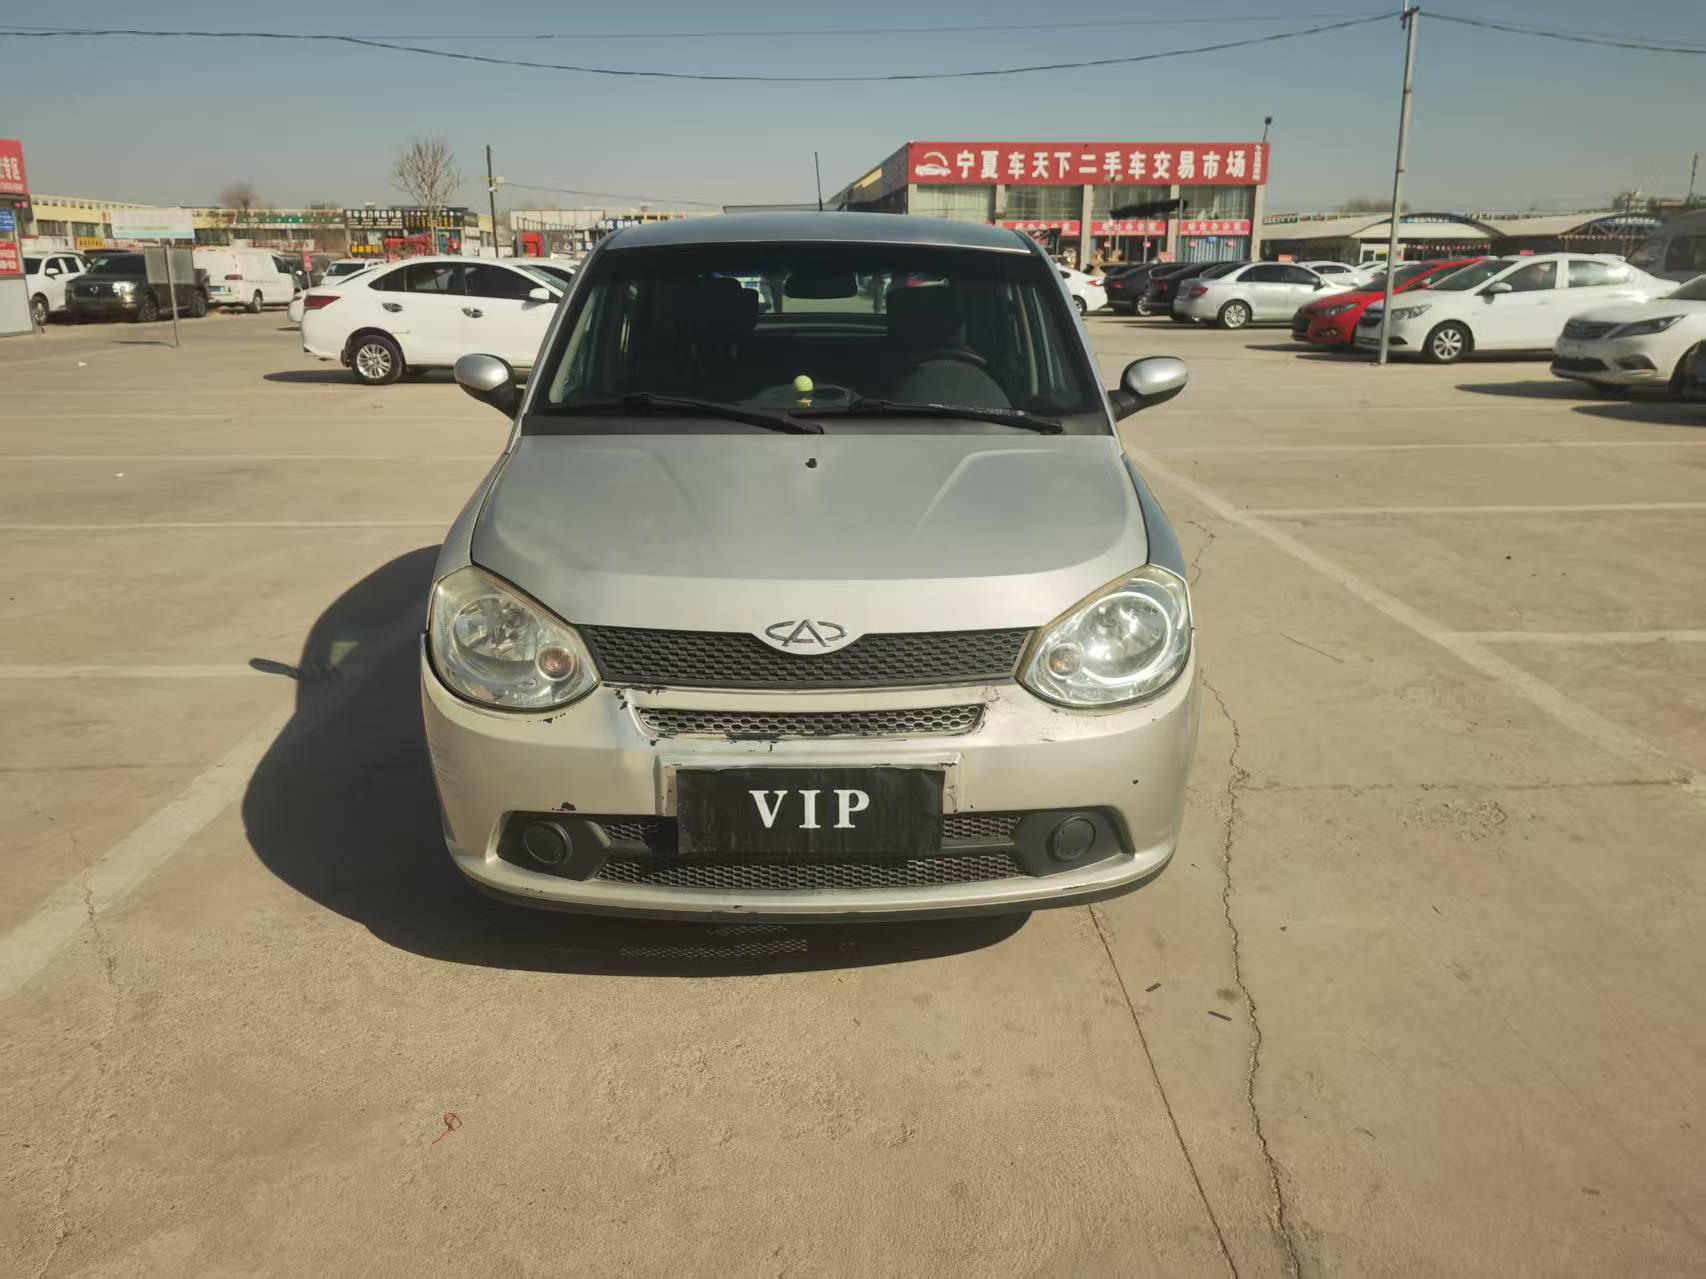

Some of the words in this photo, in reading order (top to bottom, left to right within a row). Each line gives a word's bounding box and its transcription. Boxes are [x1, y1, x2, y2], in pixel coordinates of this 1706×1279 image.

[956, 150, 1246, 180] 宁夏车天下二手车交易市场
[748, 789, 870, 829] VIP
